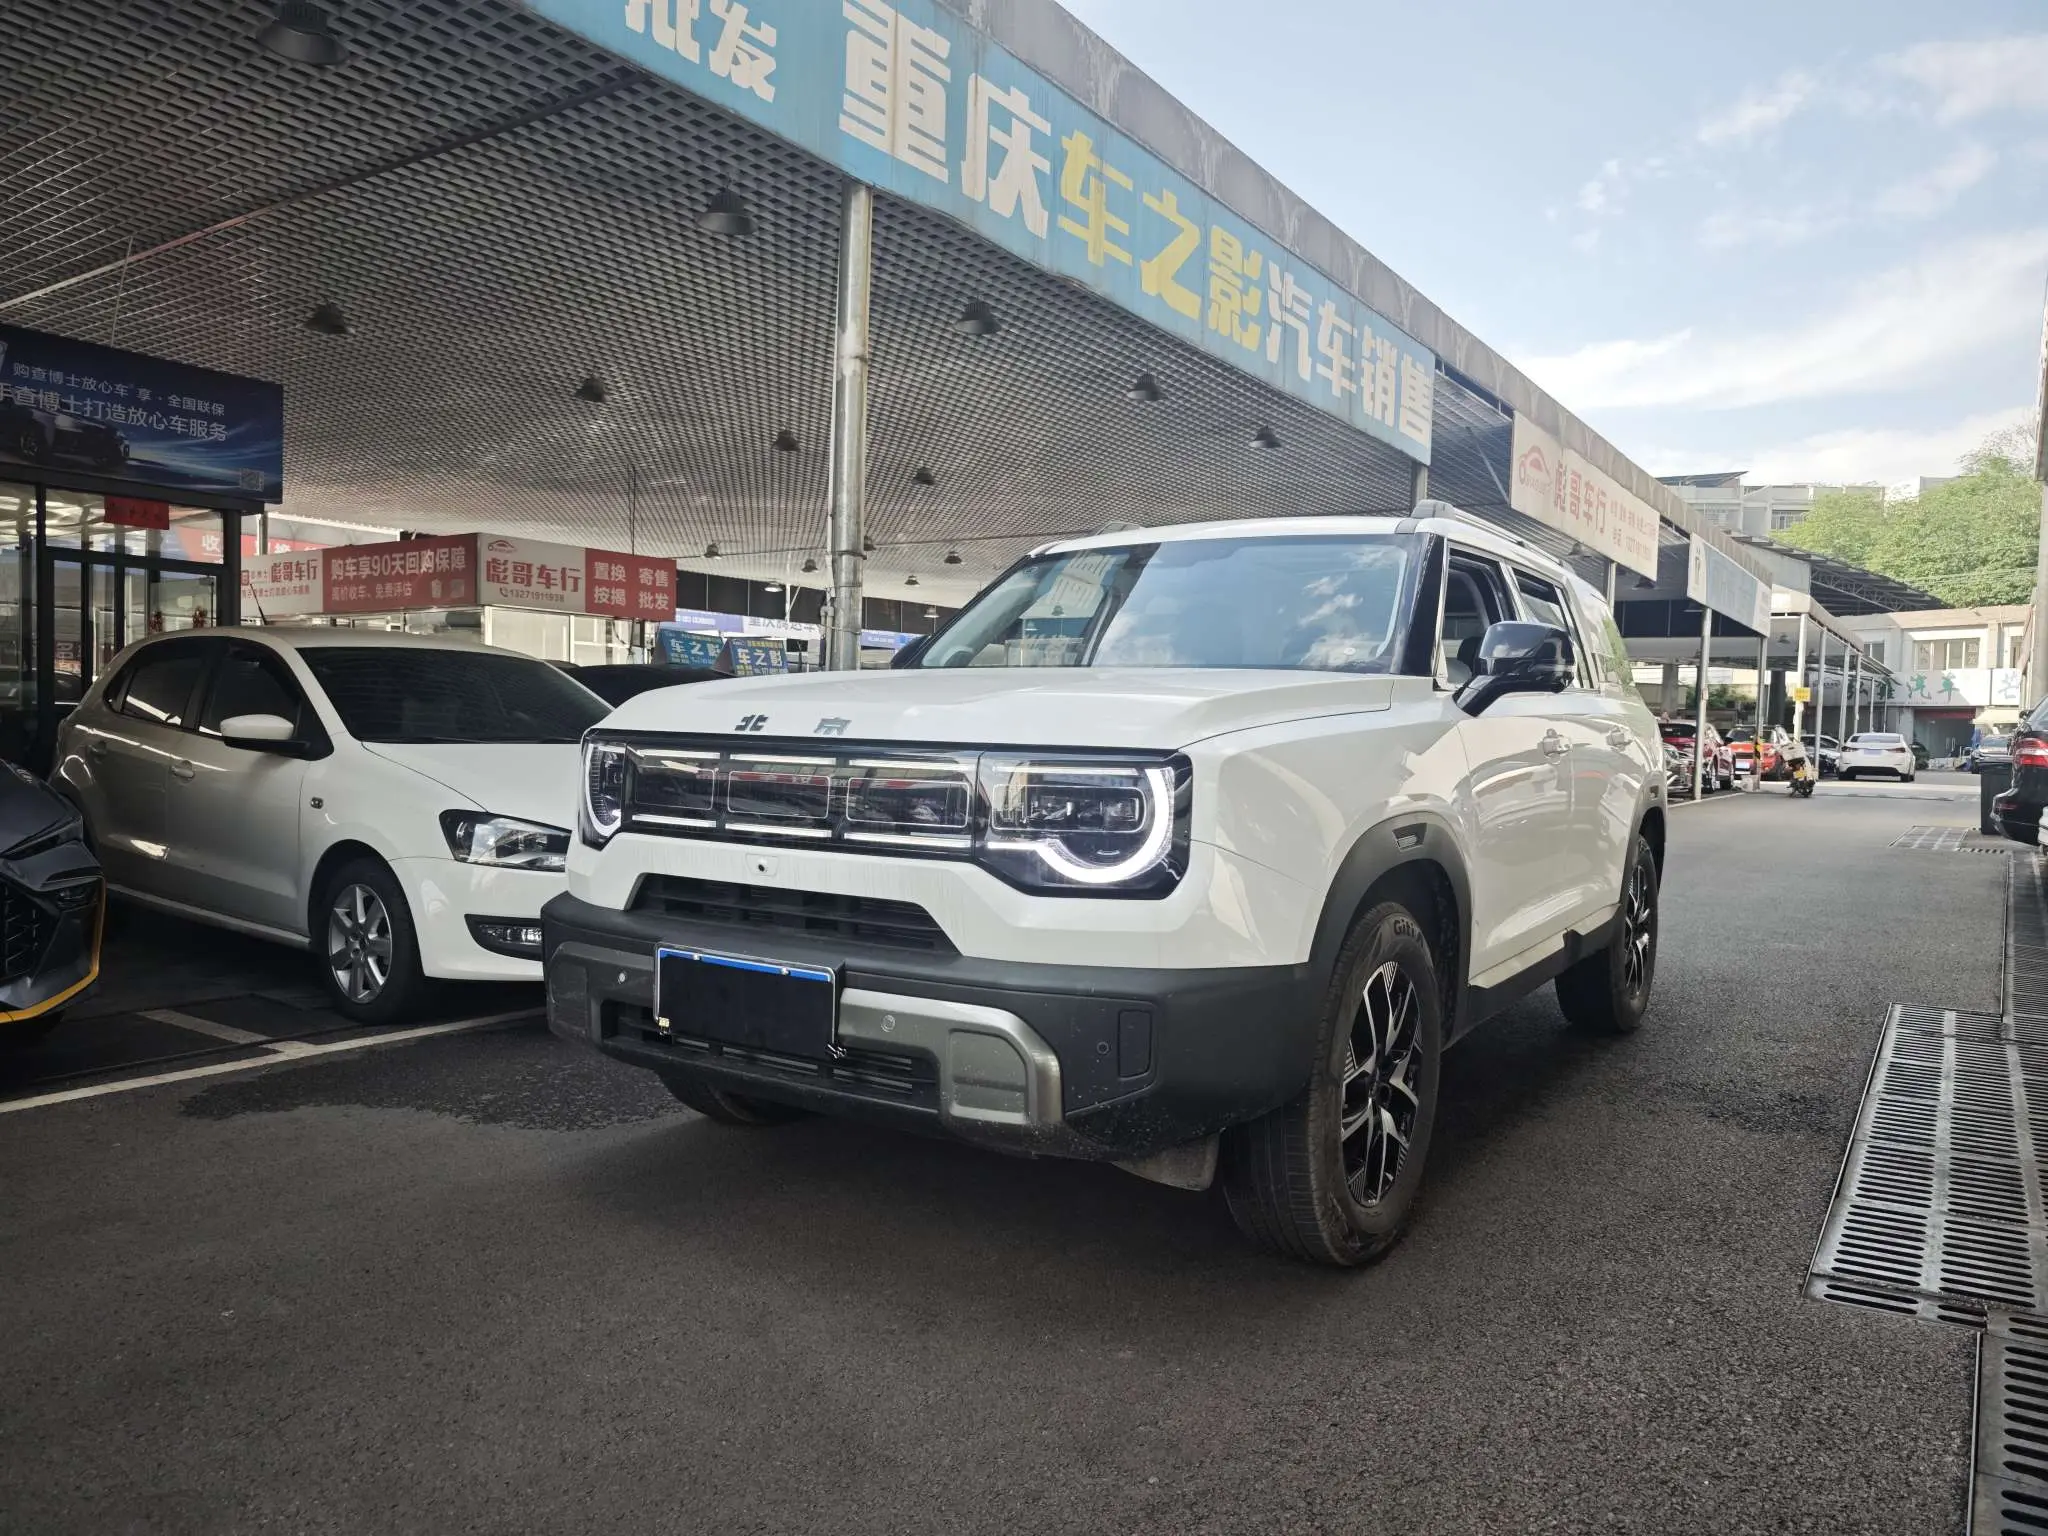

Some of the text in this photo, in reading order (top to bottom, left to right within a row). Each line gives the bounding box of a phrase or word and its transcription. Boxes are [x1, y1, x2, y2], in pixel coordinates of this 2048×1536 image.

[331, 546, 466, 581] 购车享90天回购保障
[486, 557, 582, 592] 彪哥车行
[594, 561, 669, 588] 置换 寄售
[594, 586, 669, 611] 按揭 批发
